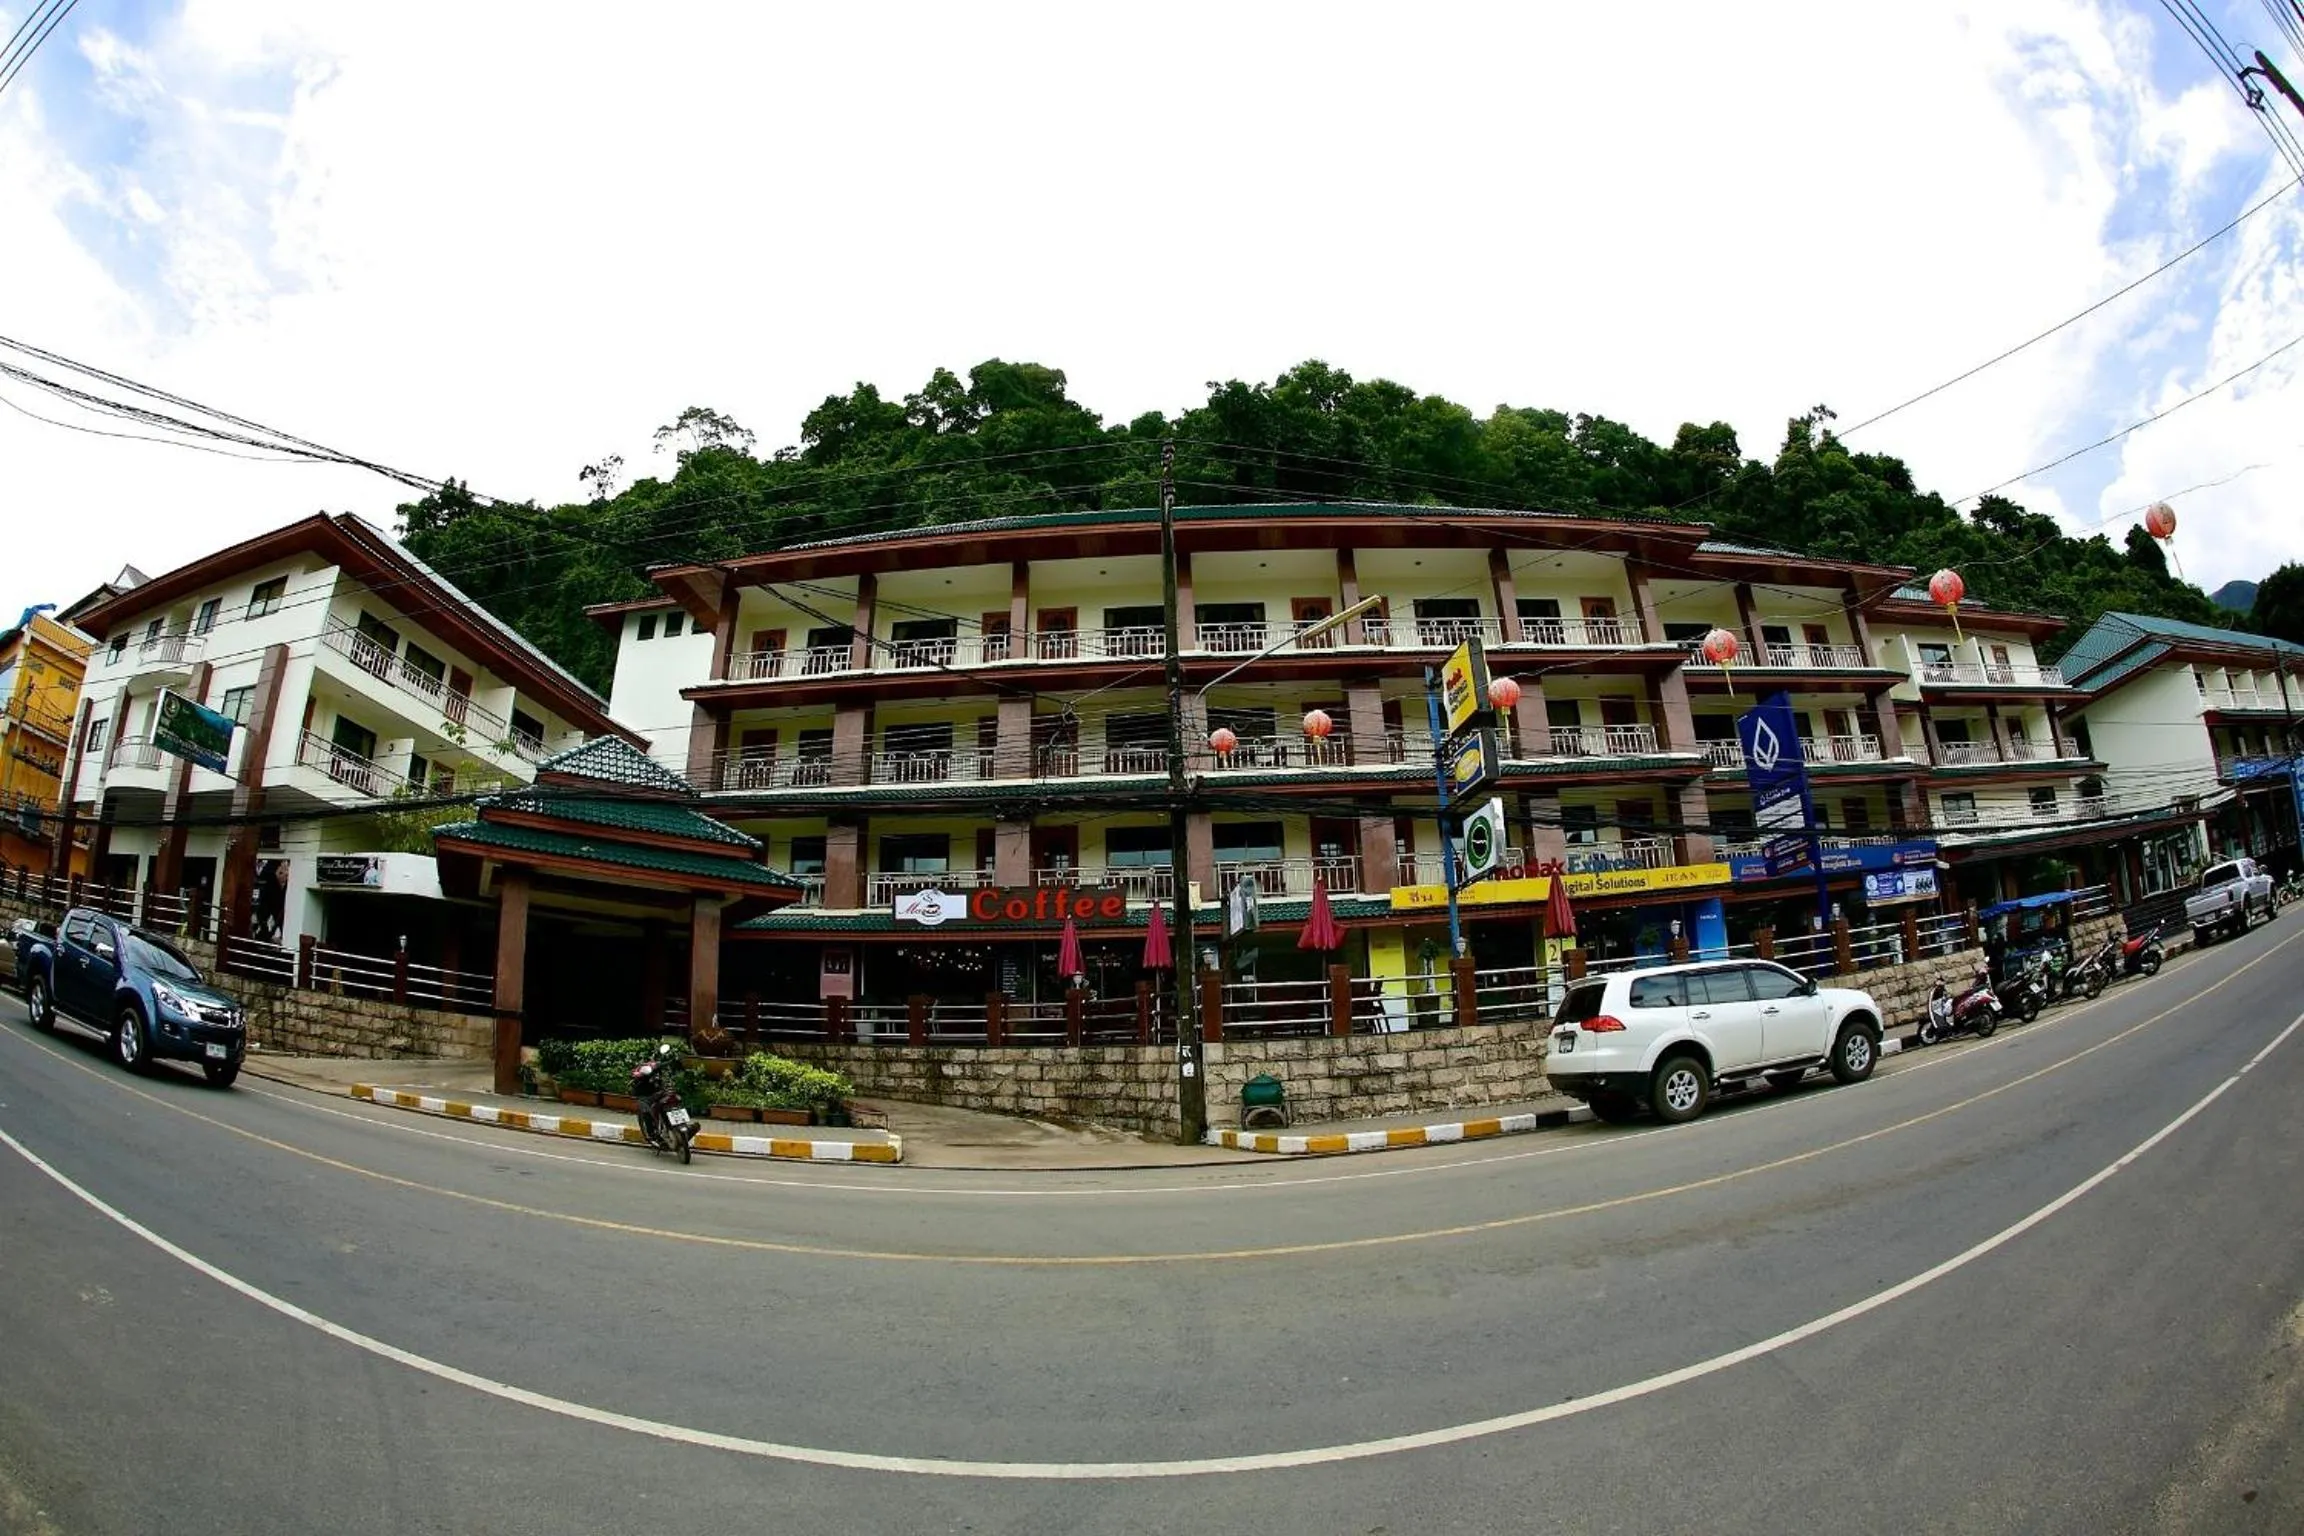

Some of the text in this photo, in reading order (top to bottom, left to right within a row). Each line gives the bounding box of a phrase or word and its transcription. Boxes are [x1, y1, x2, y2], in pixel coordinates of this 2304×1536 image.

[1564, 874, 1646, 895] igital Solutions
[1662, 871, 1699, 883] JEAN
[971, 888, 1123, 921] Coffee
